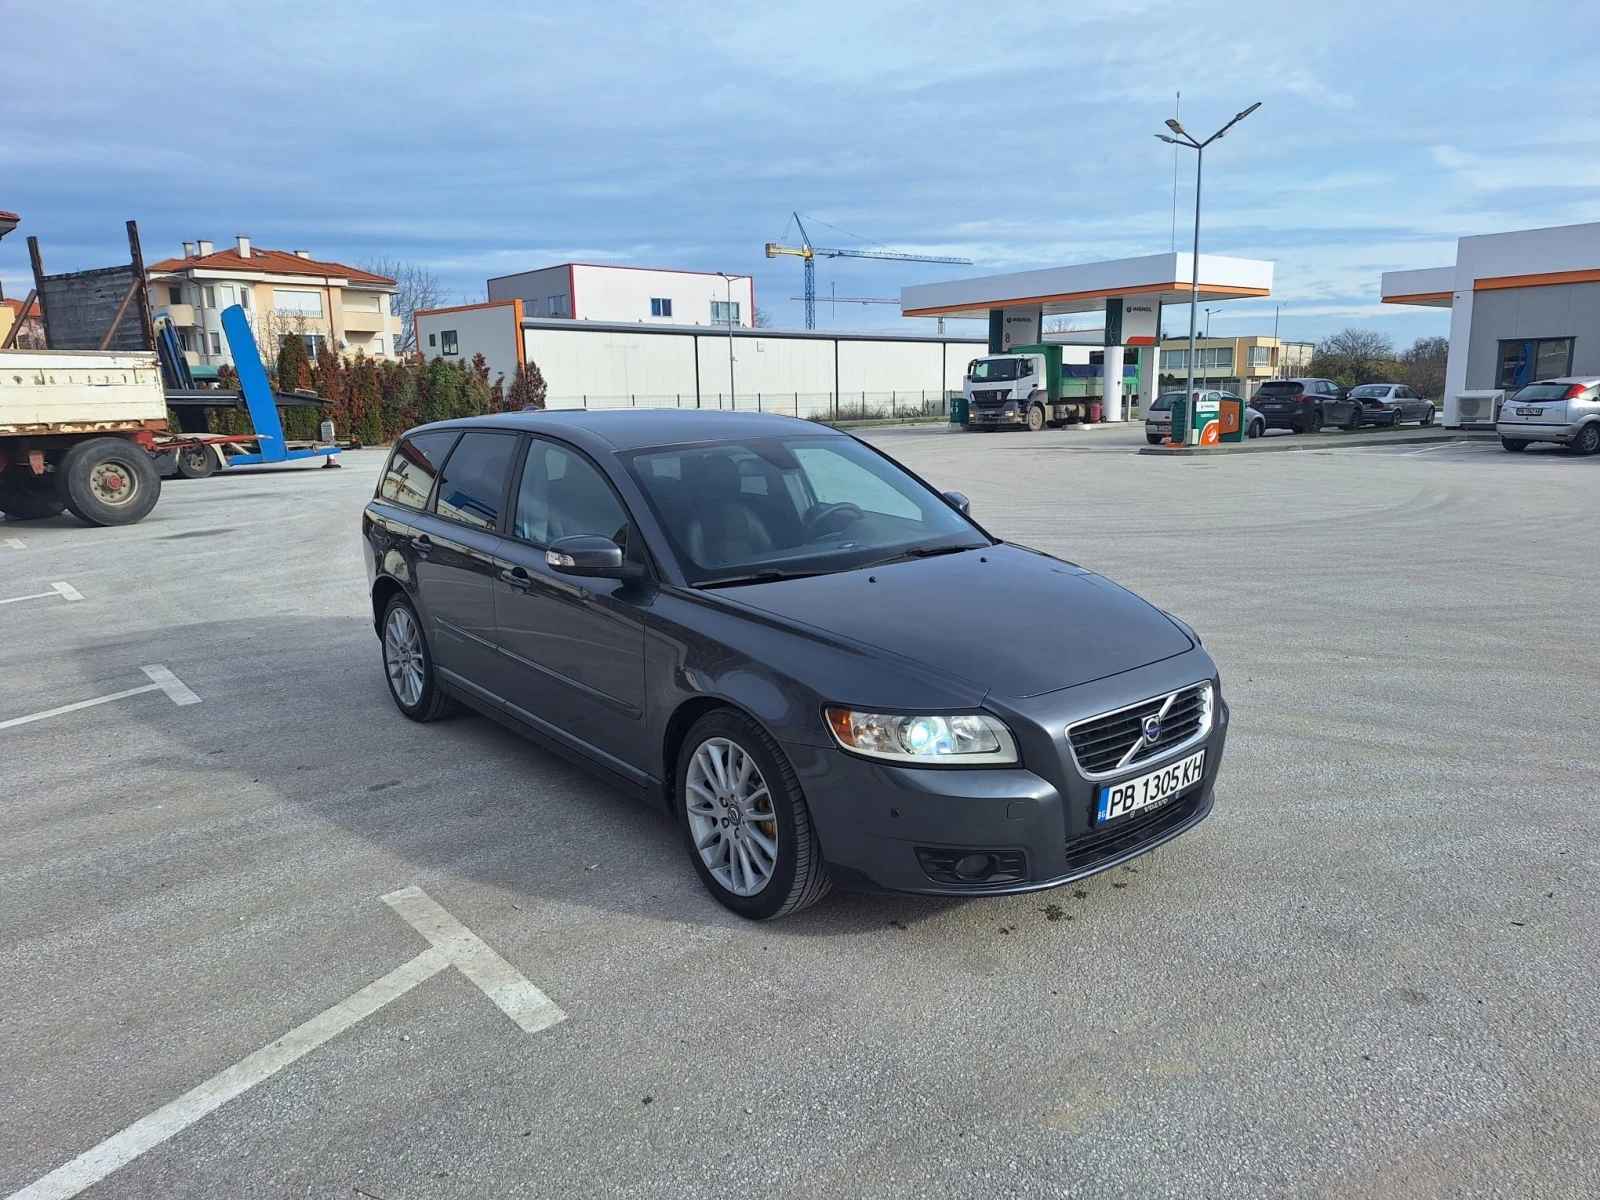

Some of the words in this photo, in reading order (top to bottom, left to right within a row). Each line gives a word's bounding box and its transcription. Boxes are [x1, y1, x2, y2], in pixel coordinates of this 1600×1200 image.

[1004, 333, 1011, 343] 8
[1109, 785, 1135, 816] PB
[1142, 764, 1181, 804] 1305
[1181, 753, 1203, 786] KH
